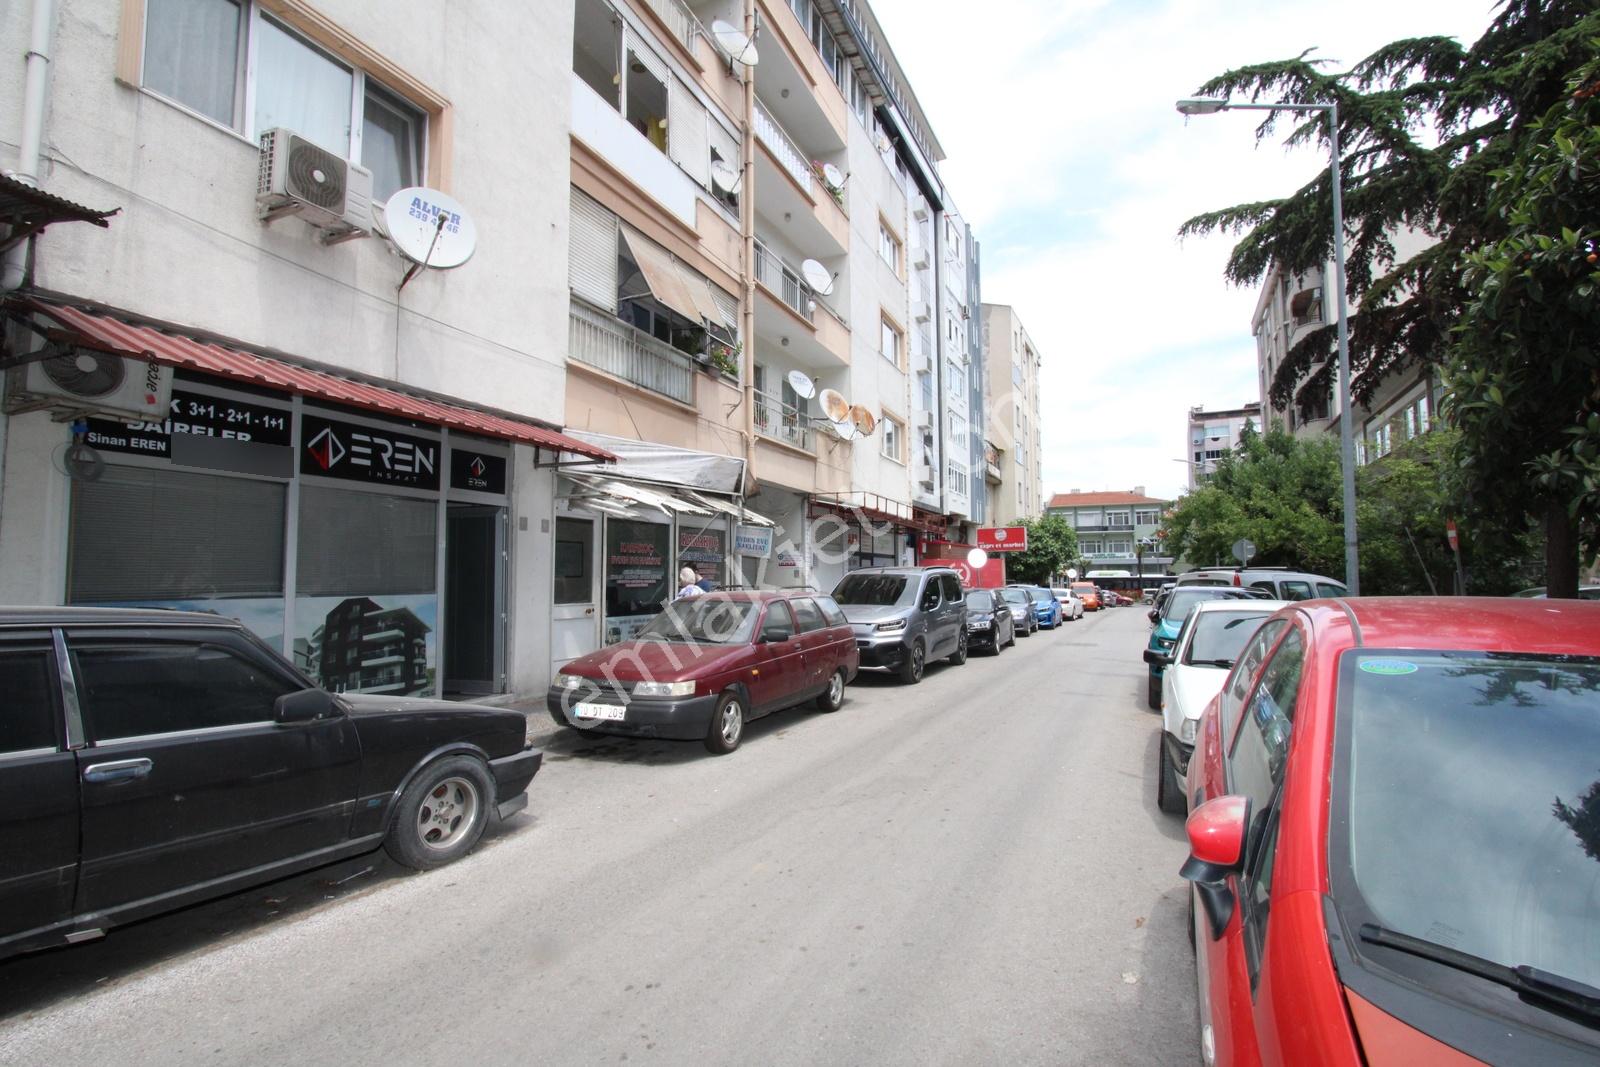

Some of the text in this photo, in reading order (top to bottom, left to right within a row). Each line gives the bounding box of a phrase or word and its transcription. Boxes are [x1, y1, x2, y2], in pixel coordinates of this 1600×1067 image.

[408, 207, 428, 223] 239
[188, 402, 214, 419] 3+1
[227, 408, 251, 425] 2+1
[263, 415, 285, 431] 1+1
[87, 432, 167, 451] Sinan EREN
[351, 433, 434, 475] EREN
